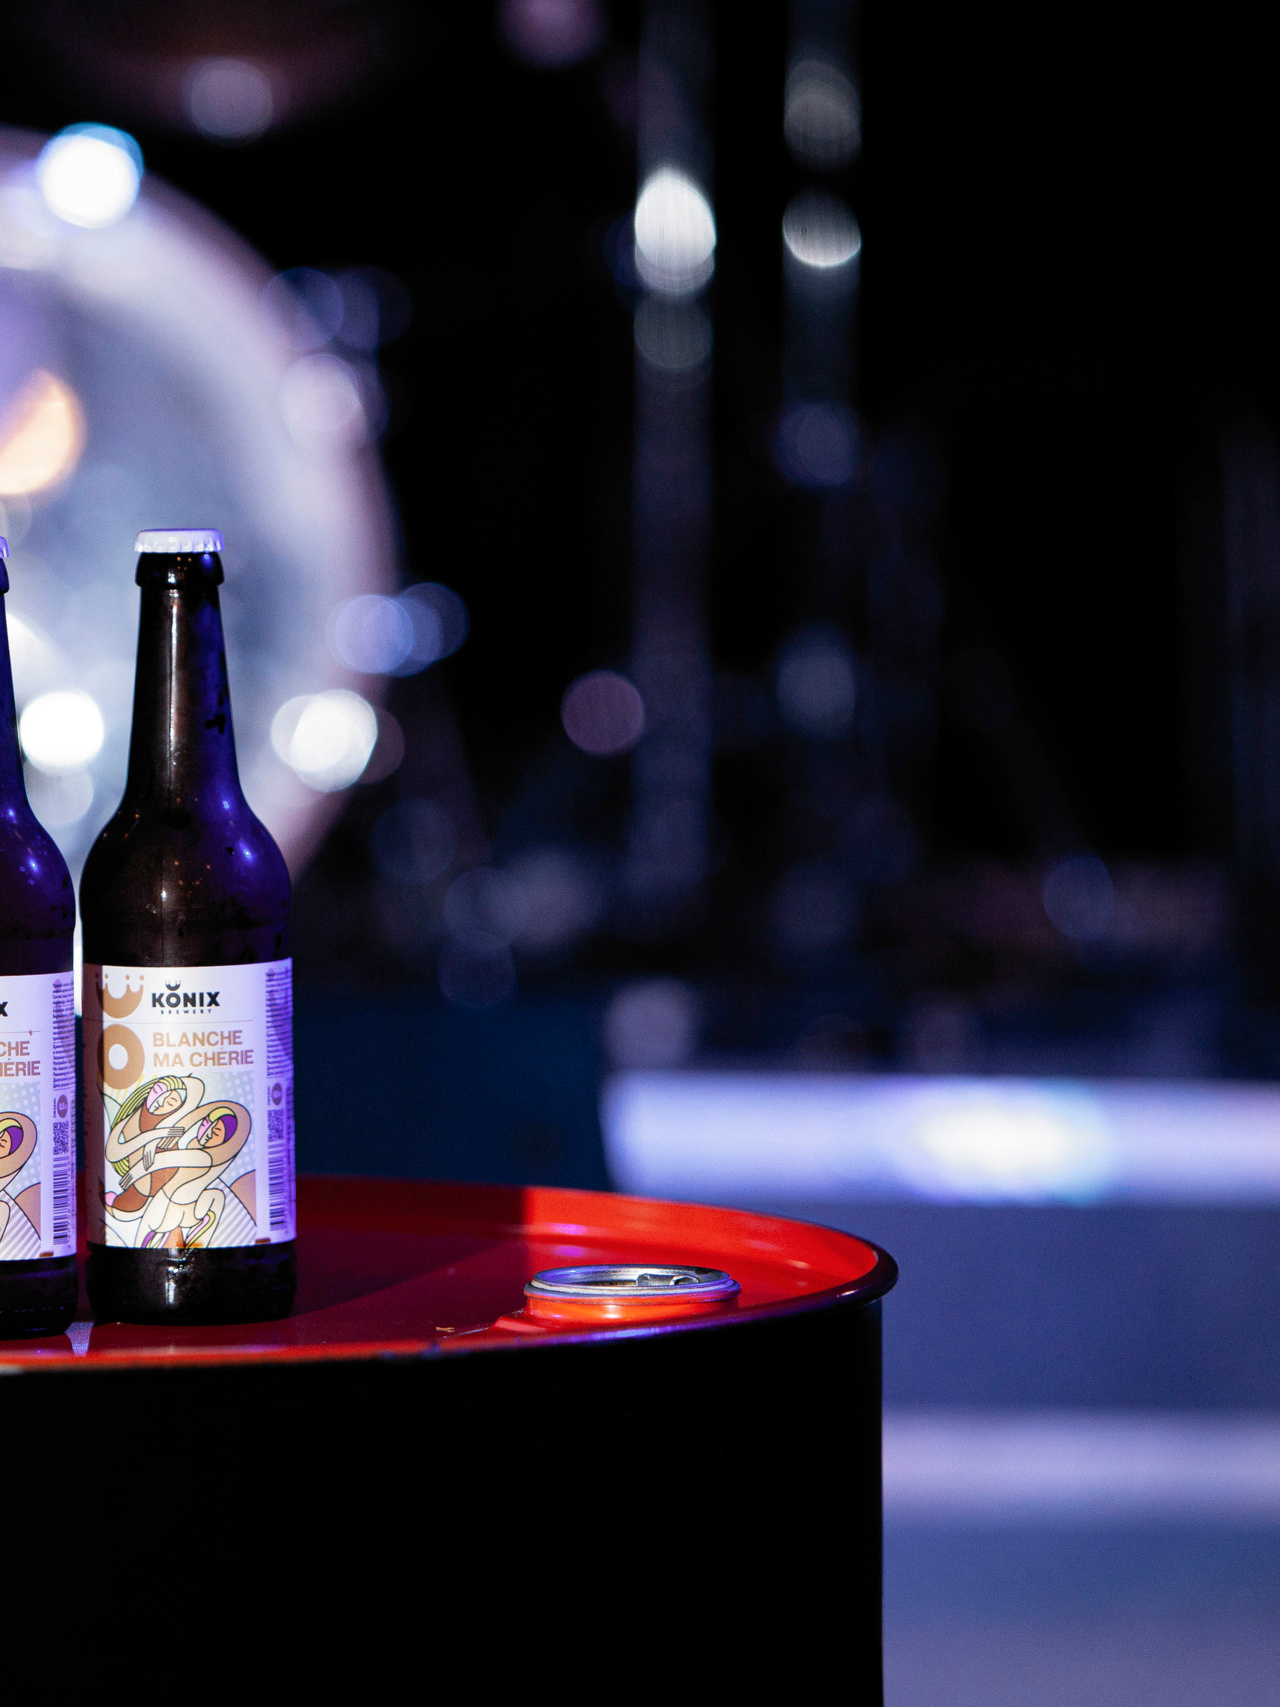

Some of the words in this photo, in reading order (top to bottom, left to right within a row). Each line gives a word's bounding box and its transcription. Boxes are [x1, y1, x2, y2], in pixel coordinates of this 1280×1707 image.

[153, 1030, 243, 1047] BLANCHE
[153, 1051, 184, 1068] MA
[189, 1047, 254, 1067] CHÉRIE
